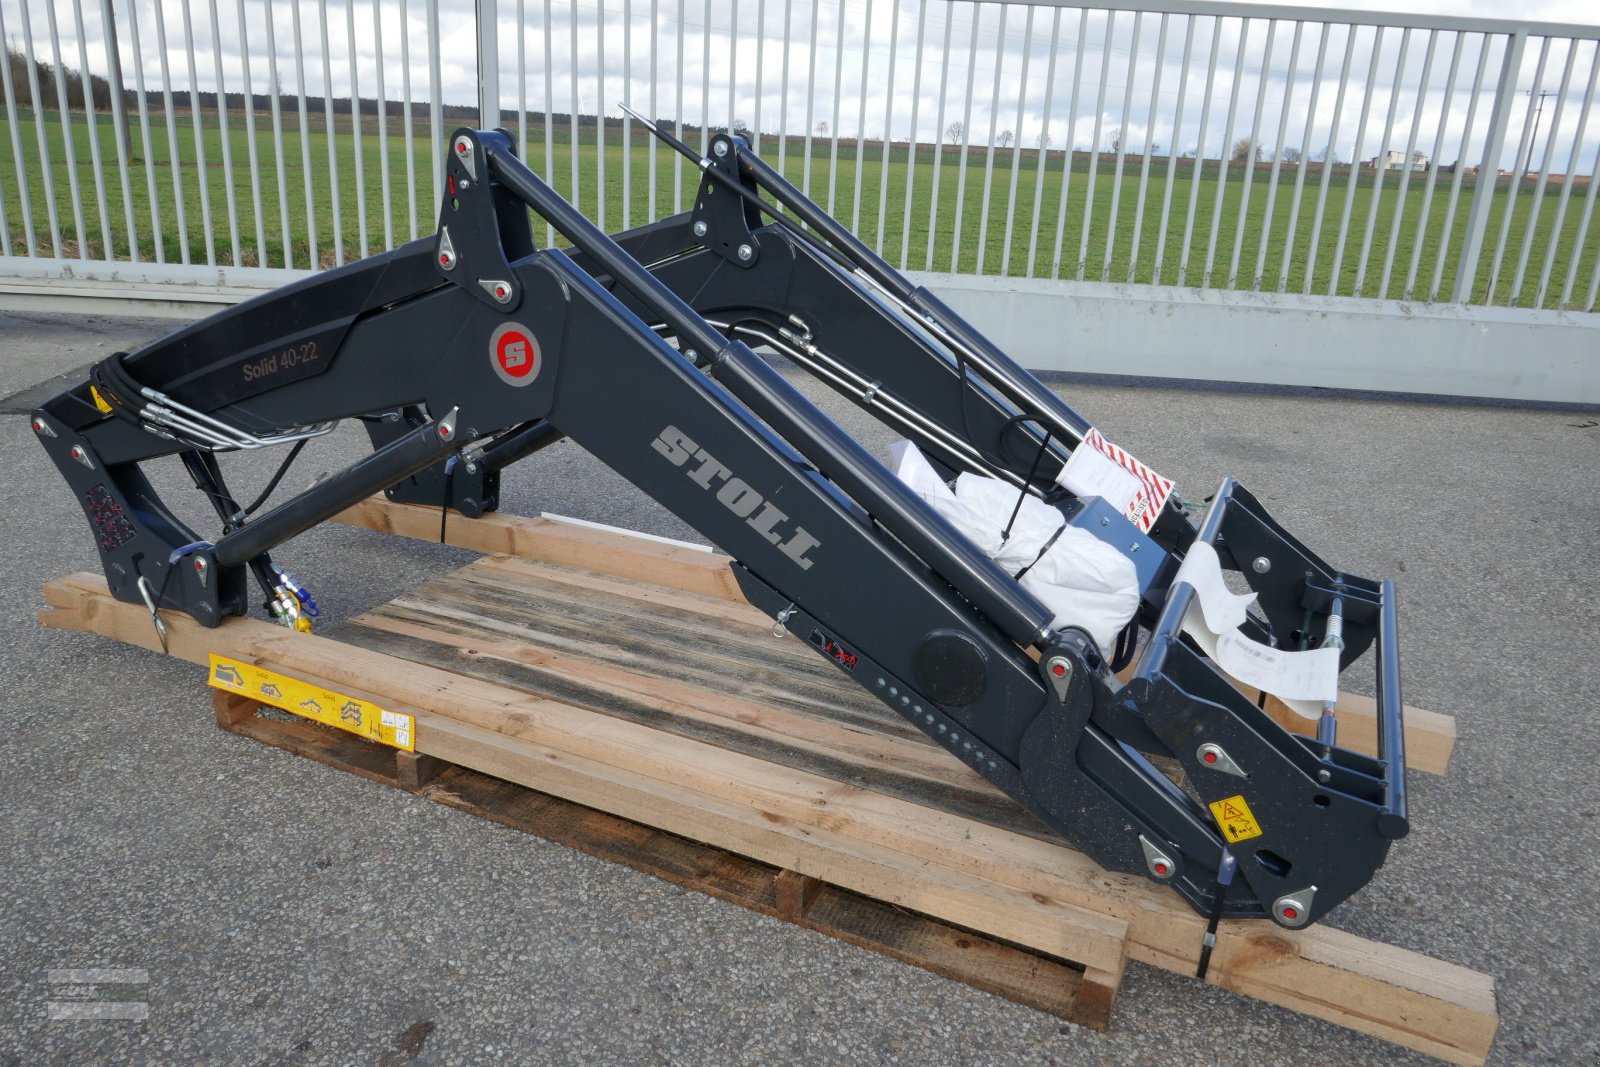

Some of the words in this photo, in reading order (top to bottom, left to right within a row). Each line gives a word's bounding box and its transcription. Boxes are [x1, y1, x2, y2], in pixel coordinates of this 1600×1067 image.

[243, 355, 277, 381] Solid
[281, 342, 318, 368] 40-22
[504, 340, 526, 369] S
[650, 424, 822, 571] STOLL
[323, 692, 336, 702] Solid
